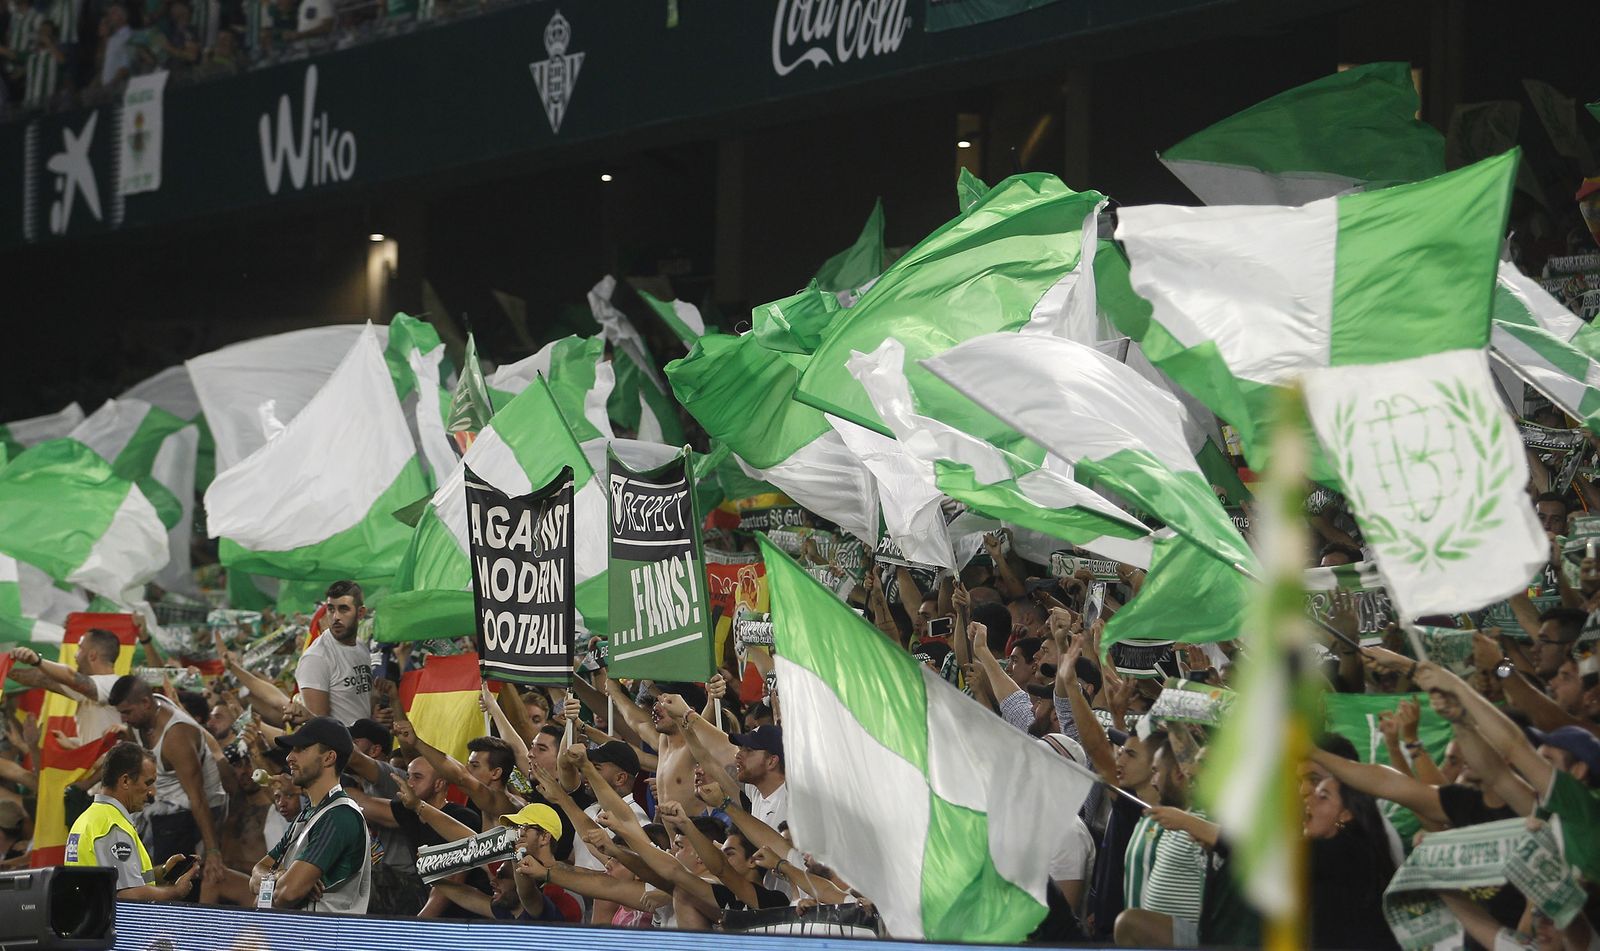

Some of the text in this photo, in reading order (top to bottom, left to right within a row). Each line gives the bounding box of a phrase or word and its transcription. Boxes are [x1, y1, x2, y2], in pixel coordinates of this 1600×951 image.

[260, 64, 356, 195] Wiko
[624, 490, 688, 532] RESPECT
[482, 607, 567, 655] OOTBALL
